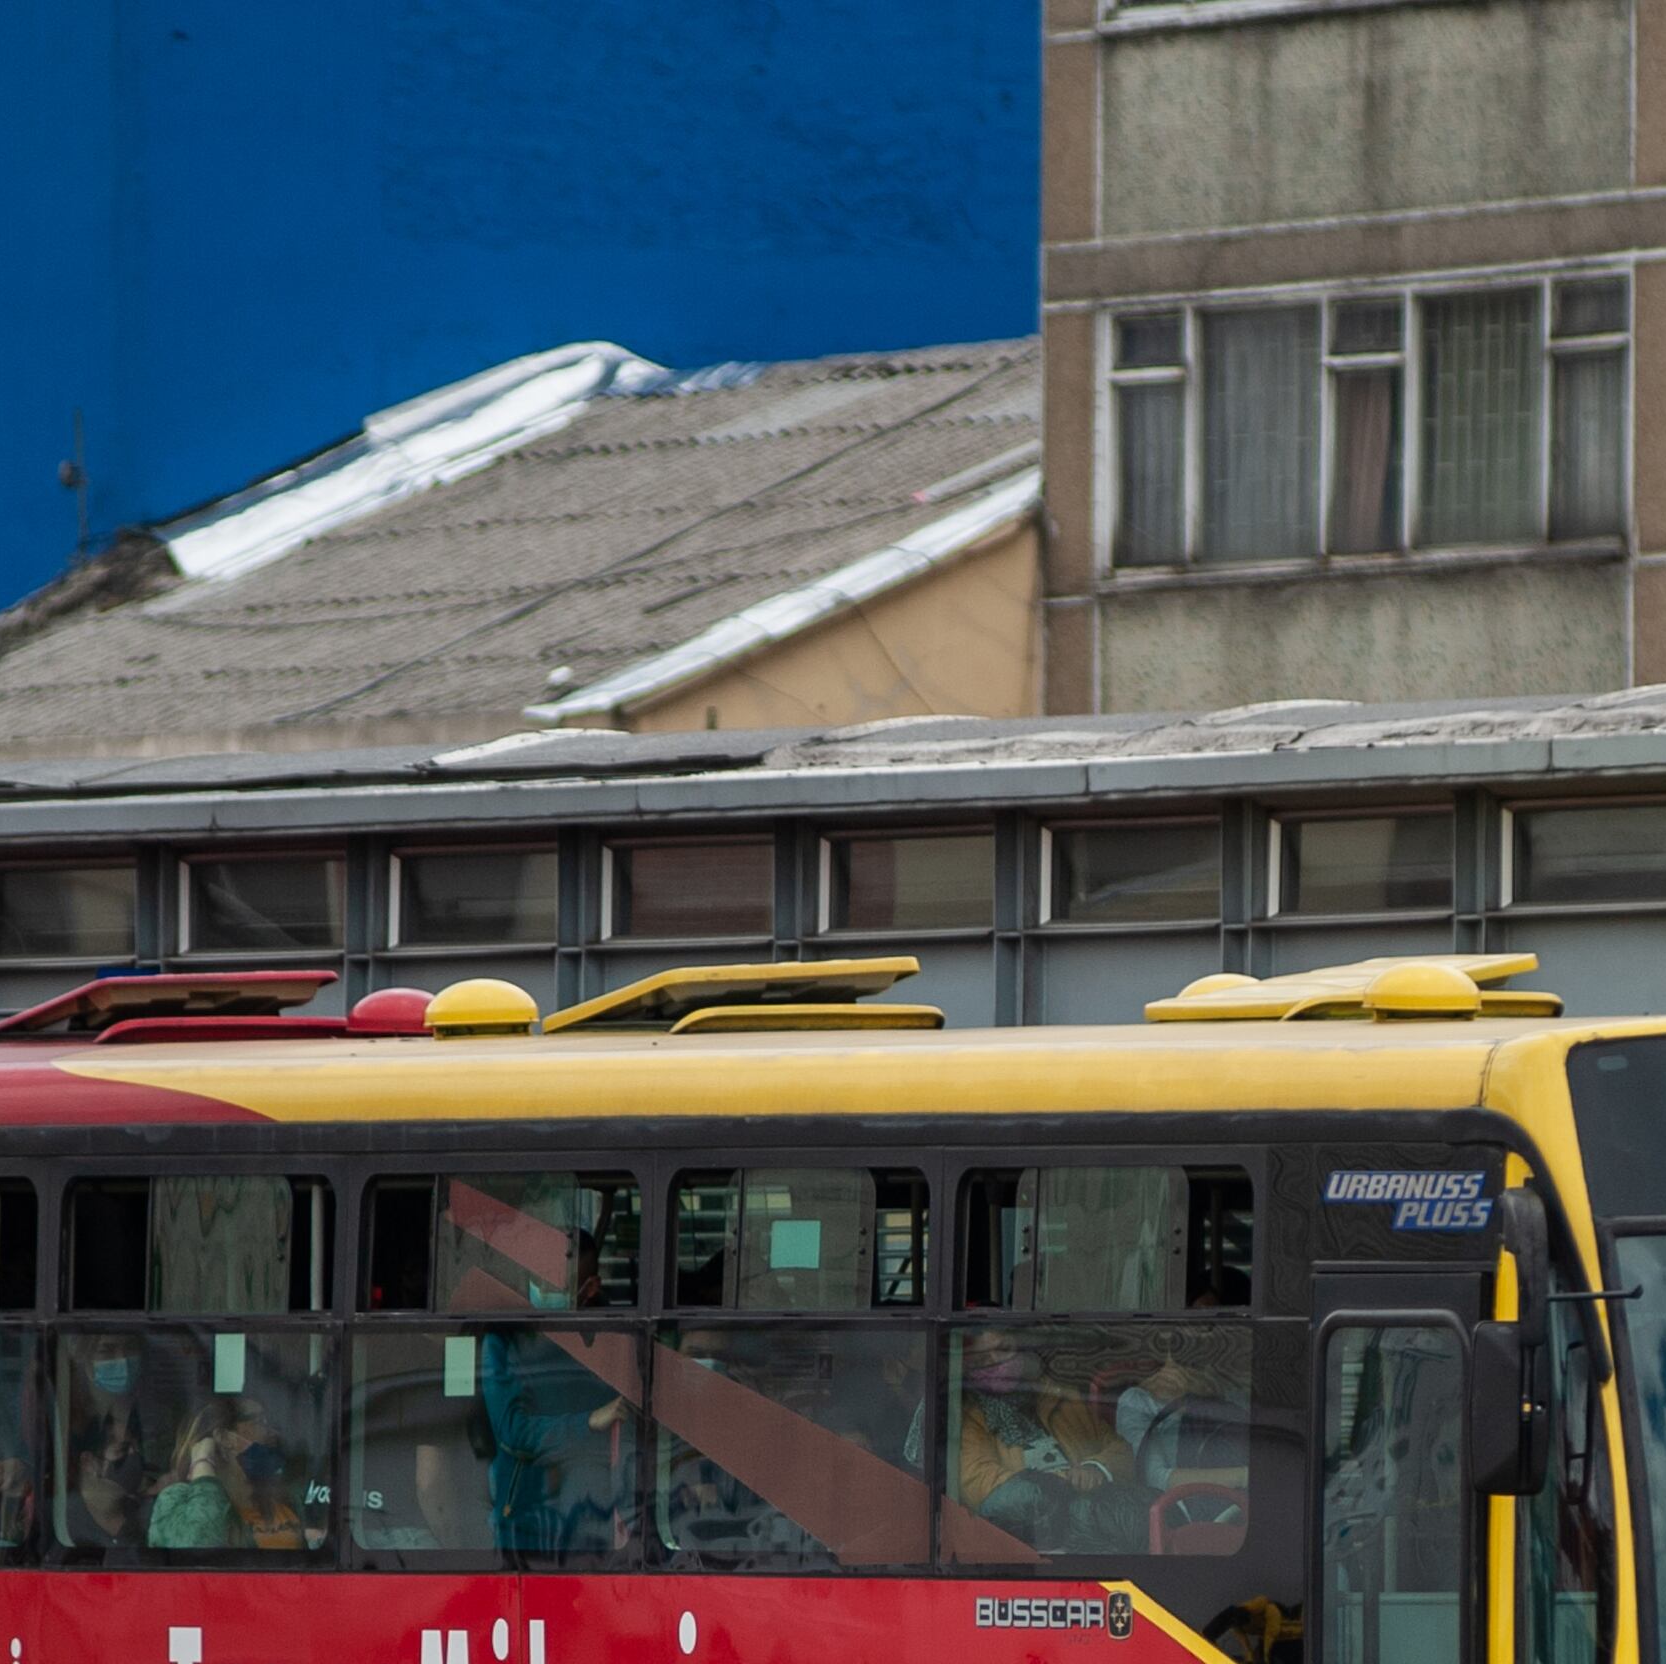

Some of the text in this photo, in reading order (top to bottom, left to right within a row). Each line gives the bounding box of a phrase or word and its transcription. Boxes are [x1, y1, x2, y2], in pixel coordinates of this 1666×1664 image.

[1326, 1173, 1484, 1200] URBANUSS
[1396, 1201, 1493, 1228] PLUSS
[975, 1597, 1105, 1629] BUSSCAR
